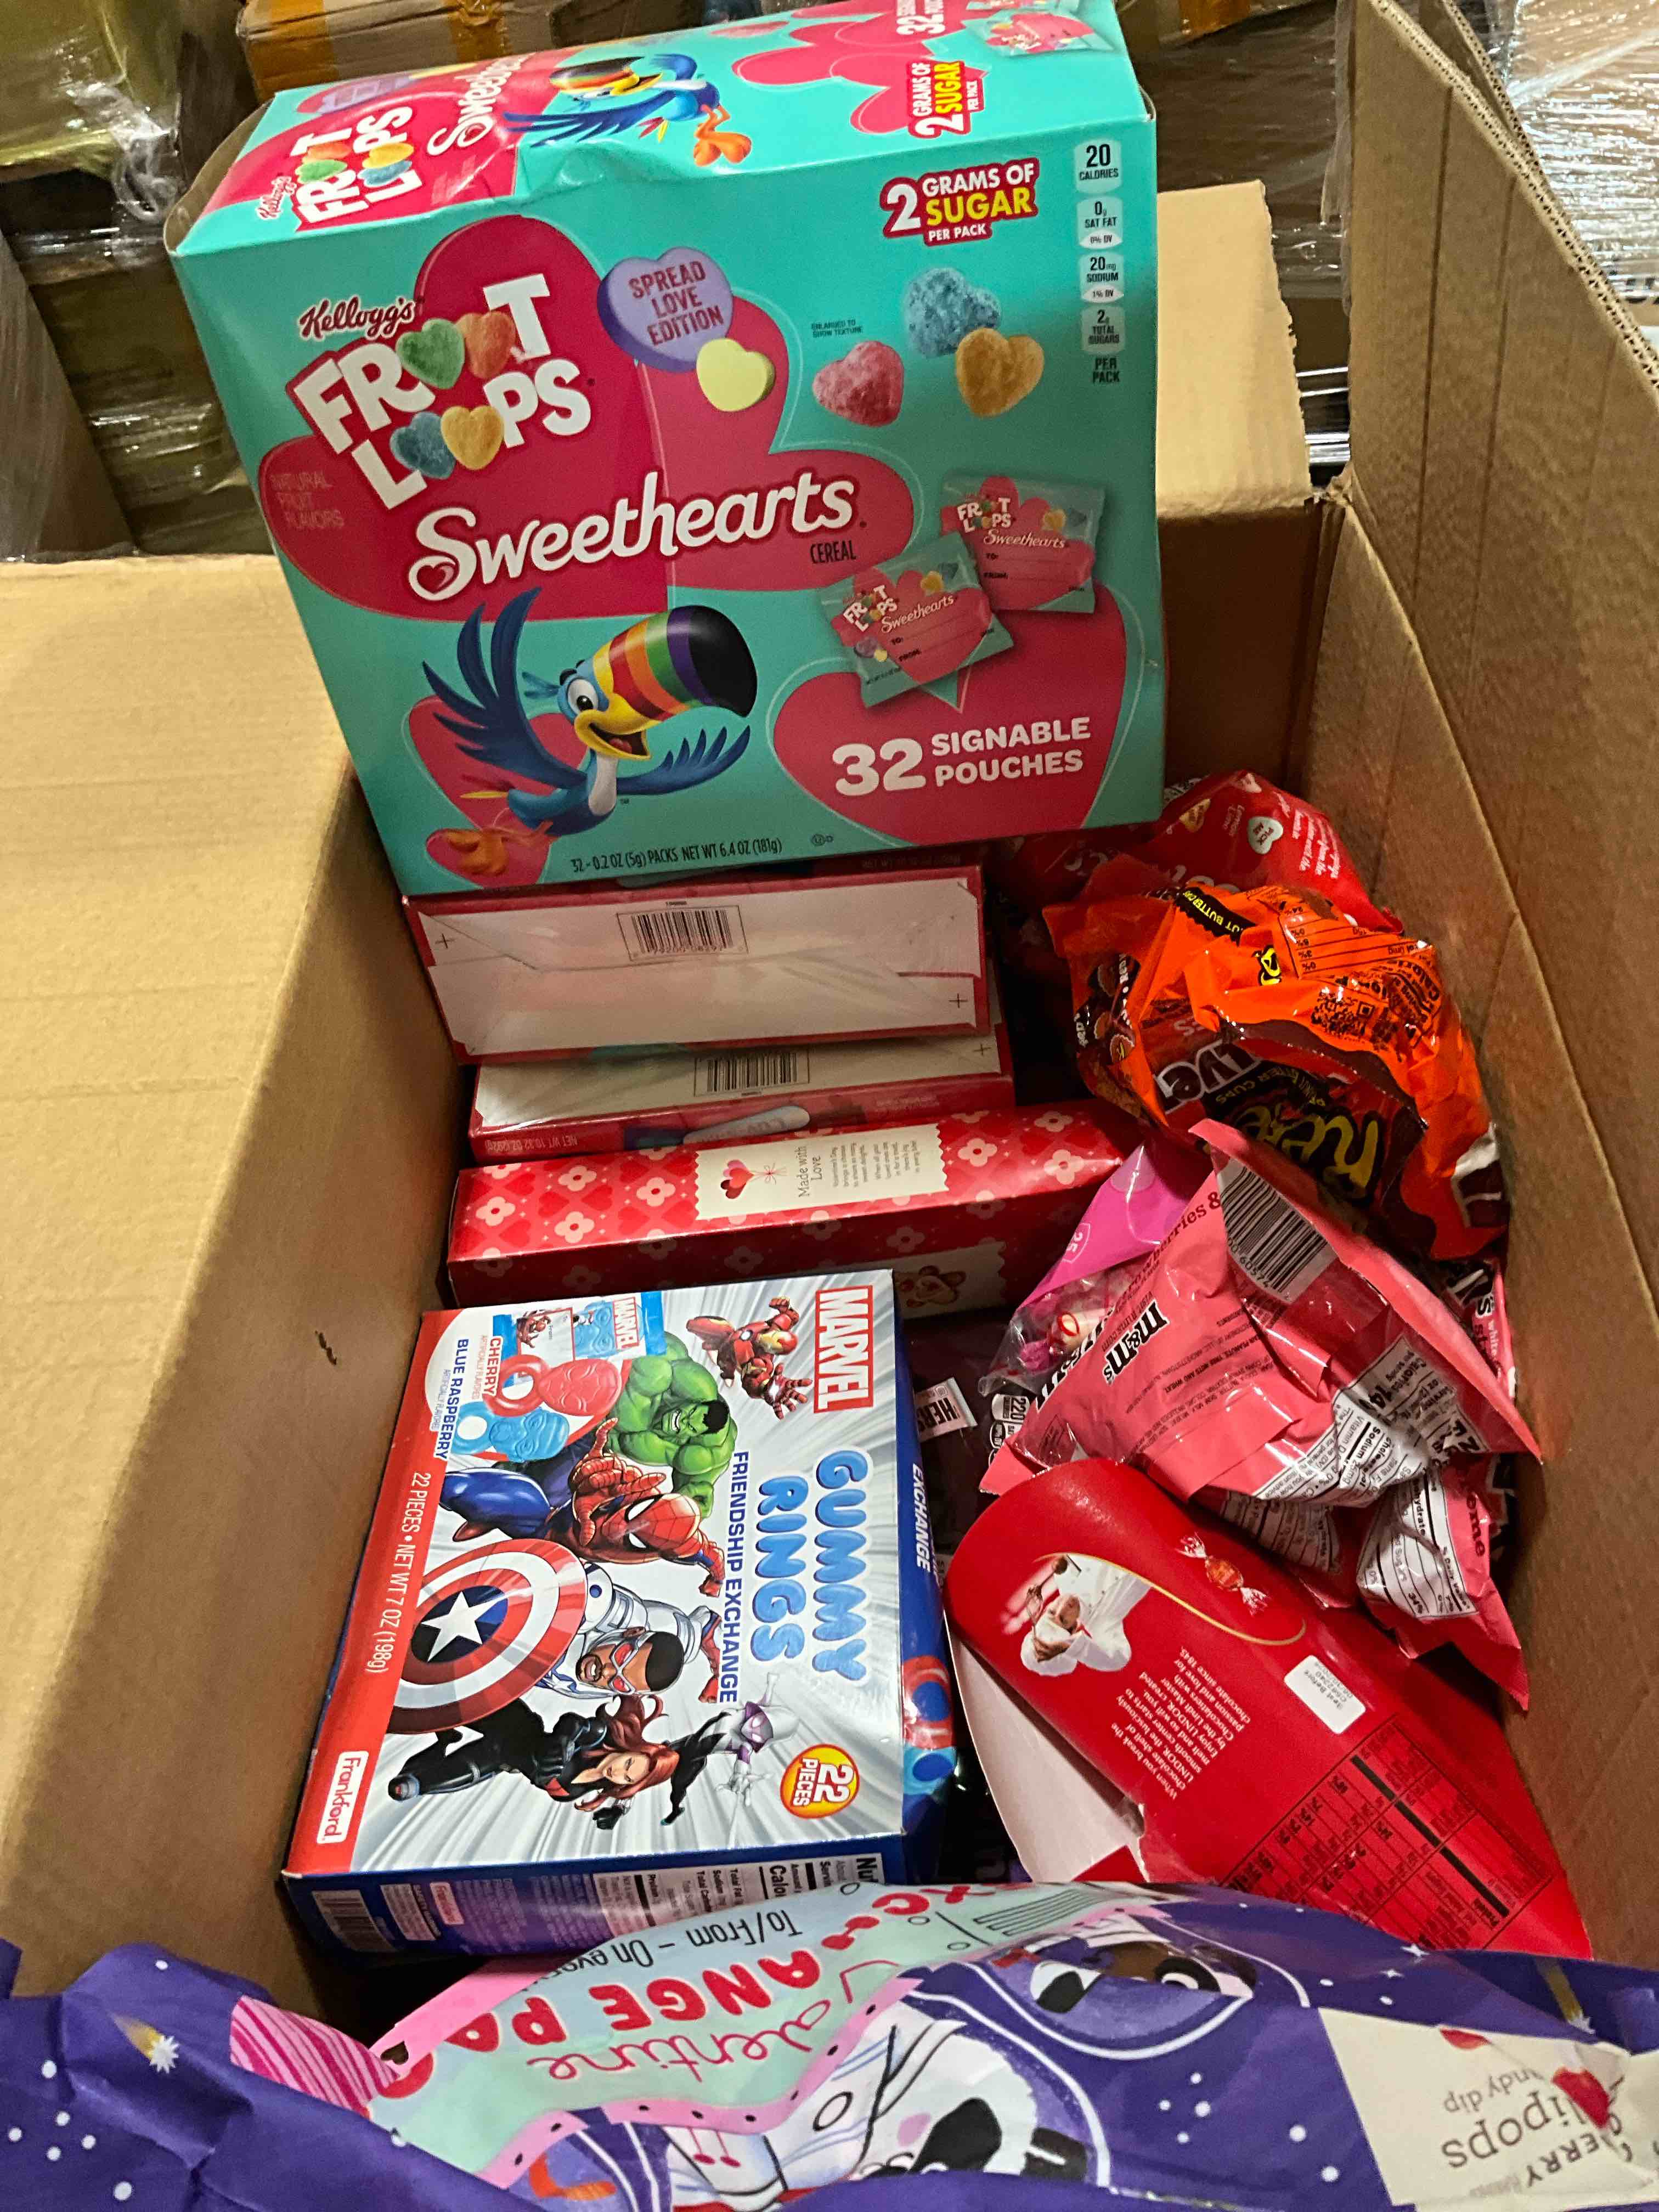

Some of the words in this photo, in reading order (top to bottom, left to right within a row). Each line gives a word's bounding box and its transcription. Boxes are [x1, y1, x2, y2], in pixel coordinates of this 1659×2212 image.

[912, 63, 932, 75] OF
[912, 76, 932, 116] GRAMS
[934, 61, 964, 114] SUGAR
[915, 114, 964, 135] 2
[354, 105, 422, 206] LPS
[1086, 143, 1111, 168] 20
[291, 127, 370, 223] FRT
[1079, 167, 1119, 181] CALORIES
[886, 182, 922, 232] 2
[922, 167, 1001, 198] GRAMS
[1006, 162, 1035, 185] OF
[924, 187, 1033, 227] SUGAR
[928, 227, 951, 242] PER
[953, 222, 987, 240] PACK
[1084, 218, 1100, 229] SAT
[1102, 217, 1116, 228] FAT
[628, 261, 706, 300] SPREAD
[1086, 272, 1119, 283] SODIUM
[650, 286, 703, 319] LOVE
[300, 298, 415, 337] Kellogg's
[646, 305, 725, 346] EDITION
[1092, 325, 1115, 334] TOTAL
[1088, 334, 1120, 345] SUGARS
[294, 274, 551, 455] FRT
[1092, 370, 1120, 384] PACK
[1094, 357, 1117, 370] PER
[351, 358, 592, 510] LPS
[408, 471, 855, 601] Sweethearts
[983, 529, 1066, 550] Sweethearts
[810, 540, 856, 565] CEREAL
[881, 594, 955, 634] Sweethearts
[931, 716, 1091, 757] SIGNABLE
[831, 737, 927, 797] 32
[935, 749, 1084, 787] POUCHES
[592, 855, 610, 871] 0.2
[610, 853, 624, 868] OZ
[625, 852, 647, 869] (5g)
[648, 847, 679, 865] PACKS
[682, 844, 701, 861] NET
[701, 842, 718, 859] WT
[719, 841, 737, 857] 6.4
[737, 840, 752, 855] OZ
[752, 838, 783, 855] (181g)
[1194, 897, 1232, 927] BUTTER
[798, 1145, 808, 1165] with
[810, 1155, 822, 1181] Love
[798, 1166, 811, 1198] Made
[613, 1296, 639, 1350] MARVEL
[456, 1338, 469, 1372] BLUE
[818, 1287, 870, 1412] MARVEL
[1101, 1301, 1169, 1386] m&m's
[483, 1338, 502, 1395] CHERRY
[436, 1376, 465, 1460] RASPBERRY
[1011, 1397, 1025, 1421] 220
[1340, 1413, 1365, 1446] Vitamin
[1355, 1424, 1383, 1460] Sodium
[411, 1472, 431, 1487] 22
[400, 1488, 428, 1533] PIECES
[726, 1451, 749, 1572] FRIENDSHIP
[911, 1463, 931, 1573] EXCHANGE
[396, 1544, 416, 1572] NET
[751, 1475, 809, 1661] RINGS
[812, 1449, 870, 1681] GUMMY
[388, 1571, 409, 1597] WT
[383, 1608, 402, 1628] OZ
[365, 1631, 395, 1674] (198g)
[719, 1576, 742, 1703] EXCHANGE
[1171, 1657, 1187, 1673] for
[1176, 1645, 1199, 1668] 1845.
[1137, 1670, 1169, 1702] created
[1159, 1676, 1187, 1705] Master
[1171, 1673, 1192, 1694] with
[1182, 1669, 1203, 1689] love
[1194, 1664, 1217, 1688] since
[1124, 1687, 1135, 1699] to
[1140, 1688, 1160, 1708] you.
[1198, 1685, 1216, 1704] and
[1213, 1684, 1252, 1724] chocolate
[1325, 1691, 1344, 1711] Best
[1113, 1693, 1154, 1734] lusciously
[1131, 1696, 1155, 1720] starts
[1154, 1705, 1173, 1724] will
[1163, 1698, 1201, 1736] LINDOR,
[1183, 1702, 1205, 1725] Lindt
[1186, 1690, 1237, 1741] Chocolatiers
[1212, 1700, 1245, 1733] passion
[1109, 1721, 1125, 1738] the
[1124, 1723, 1137, 1735] of
[1147, 1730, 1164, 1748] the
[1150, 1717, 1177, 1745] center
[1170, 1720, 1181, 1731] so
[1177, 1729, 1194, 1747] and
[1200, 1722, 1217, 1739] the
[1119, 1735, 1146, 1761] break
[1132, 1731, 1154, 1753] shell
[1190, 1745, 1211, 1765] melt
[1195, 1732, 1221, 1757] Enjoy
[1214, 1735, 1228, 1749] by
[1141, 1757, 1159, 1774] you
[1148, 1751, 1188, 1791] chocolate
[1159, 1744, 1197, 1782] LINDOR,
[1171, 1741, 1204, 1774] smooth
[793, 1757, 820, 1808] PIECES
[812, 1763, 855, 1804] 22
[1153, 1772, 1180, 1799] When
[324, 1756, 363, 1839] Frankford
[712, 1869, 725, 1894] Sodium
[729, 1868, 740, 1887] Total
[687, 1909, 804, 1949] To/From
[613, 1940, 655, 1970] On
[1443, 2086, 1483, 2114] dip
